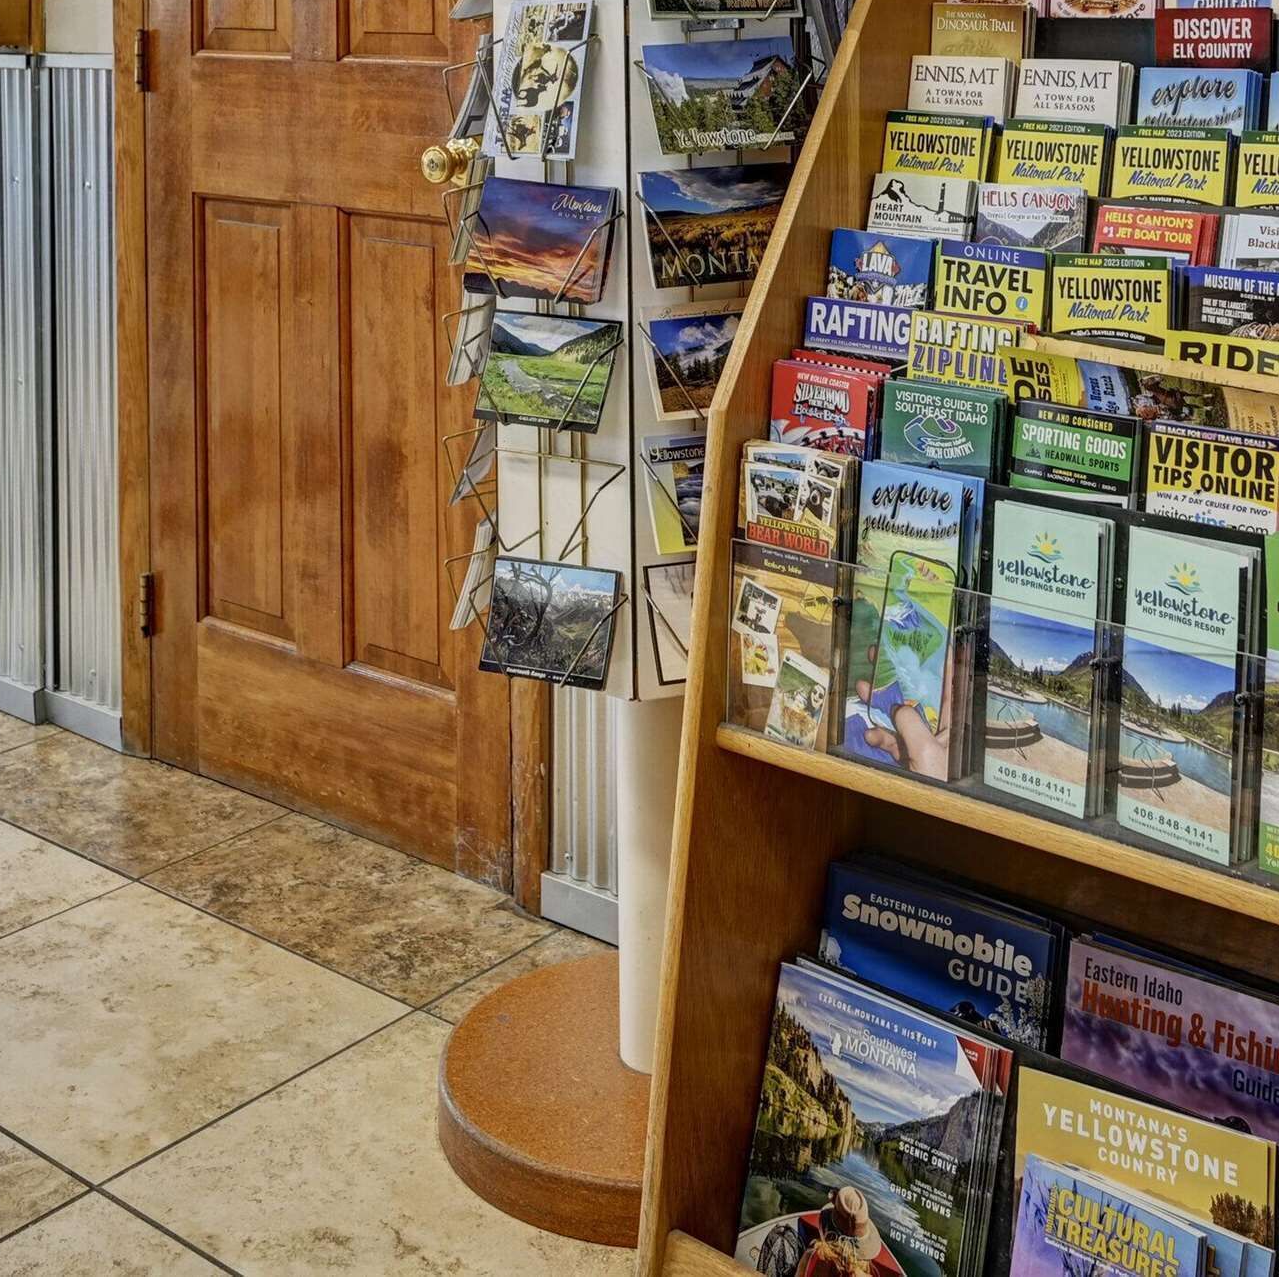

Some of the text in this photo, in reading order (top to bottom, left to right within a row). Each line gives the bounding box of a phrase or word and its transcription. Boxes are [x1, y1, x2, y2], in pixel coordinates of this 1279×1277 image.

[1173, 18, 1252, 41] DISCOVER
[1172, 42, 1252, 60] ELK COUNTRY
[1022, 69, 1112, 90] ENNIS, MT
[673, 127, 757, 149] Yellowstone
[551, 193, 603, 214] Montana
[873, 212, 922, 223] MOUNTAIN
[875, 203, 904, 213] HEART
[964, 244, 1020, 264] ONLINE
[942, 259, 1033, 294] TRAVEL
[942, 287, 1007, 316] INFO
[810, 302, 911, 345] RAFTING
[1021, 423, 1127, 460] SPORTING GOODS
[1155, 435, 1277, 482] VISITOR
[1153, 465, 1276, 503] TIPS ONLINE
[997, 558, 1093, 589] yellowstone
[841, 893, 1033, 977] Snowmobile
[946, 958, 1029, 1003] GUIDE
[1187, 1012, 1209, 1051] &
[1042, 1101, 1240, 1189] YELLOWSTONE
[1097, 1147, 1179, 1187] COUNTRY
